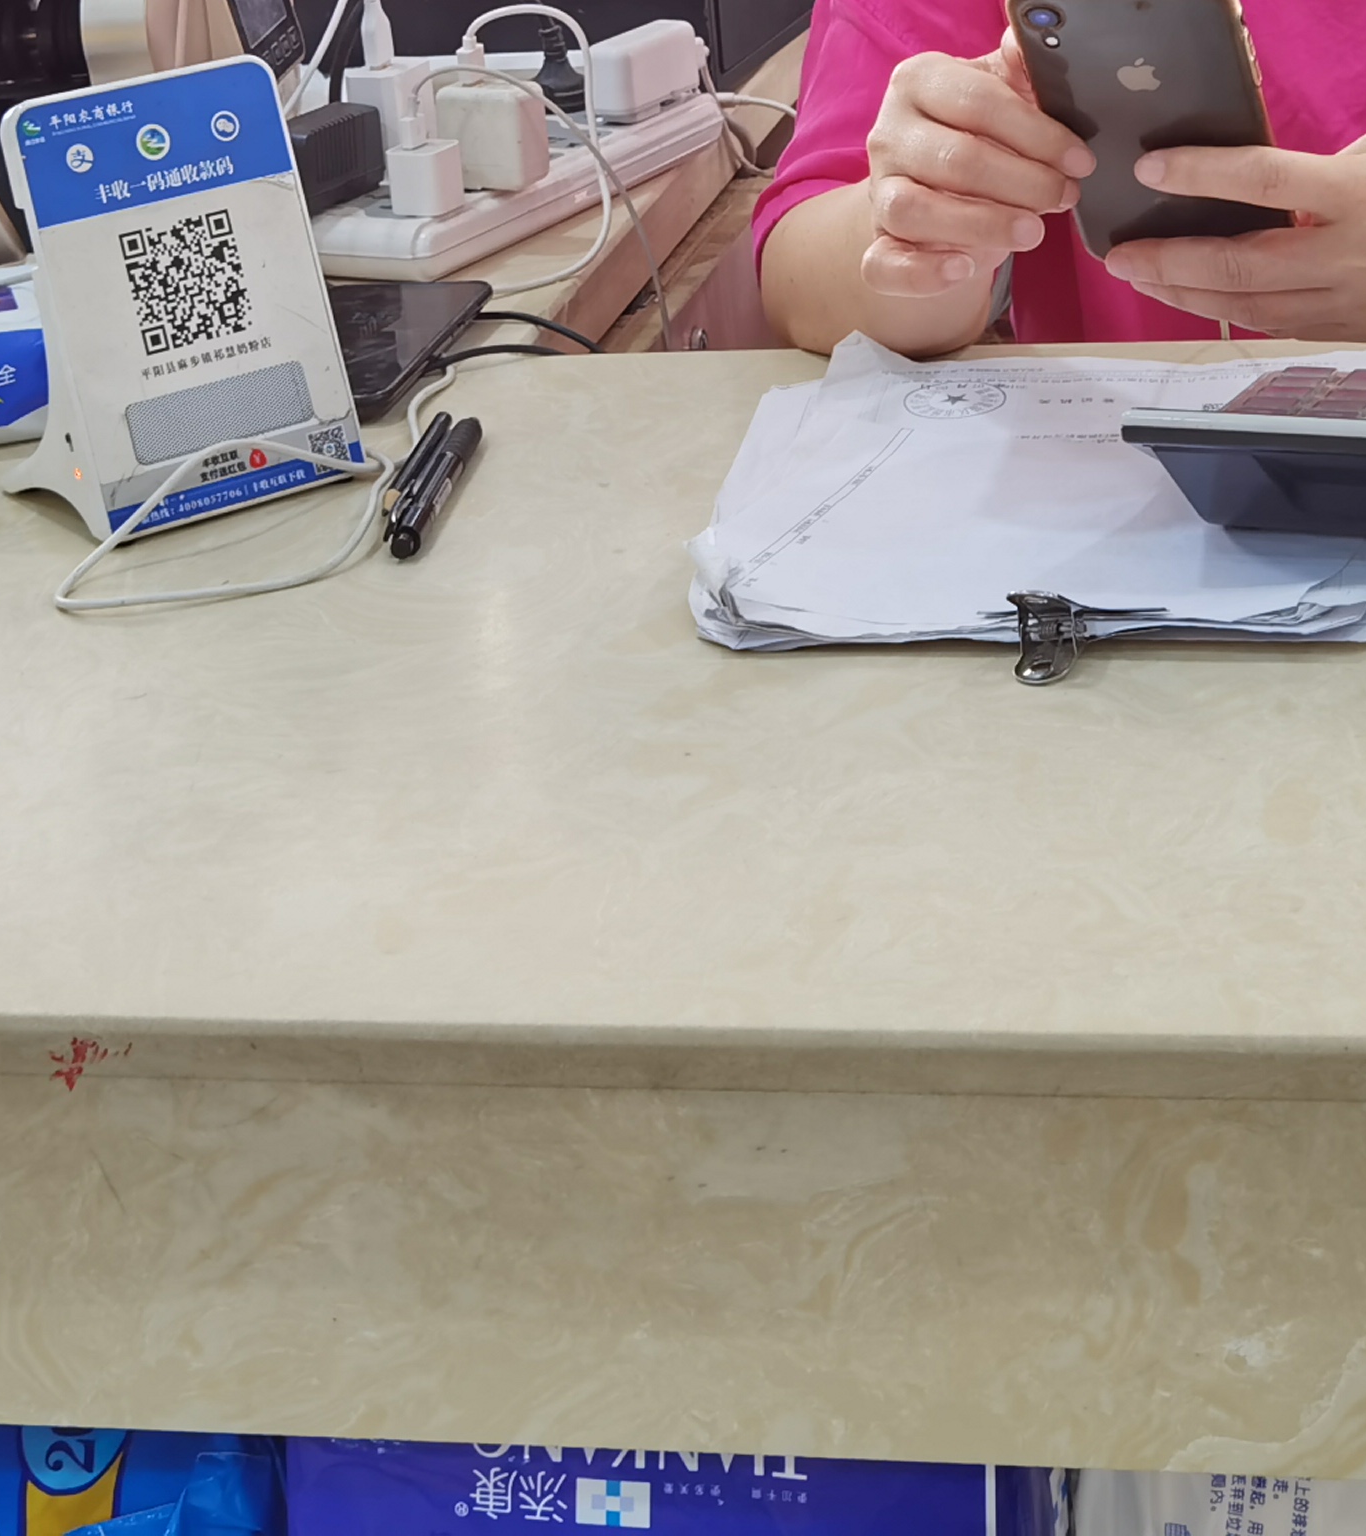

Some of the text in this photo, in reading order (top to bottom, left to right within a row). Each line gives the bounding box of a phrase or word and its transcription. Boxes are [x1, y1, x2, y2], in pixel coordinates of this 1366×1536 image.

[94, 154, 235, 205] 丰收一码通收款码
